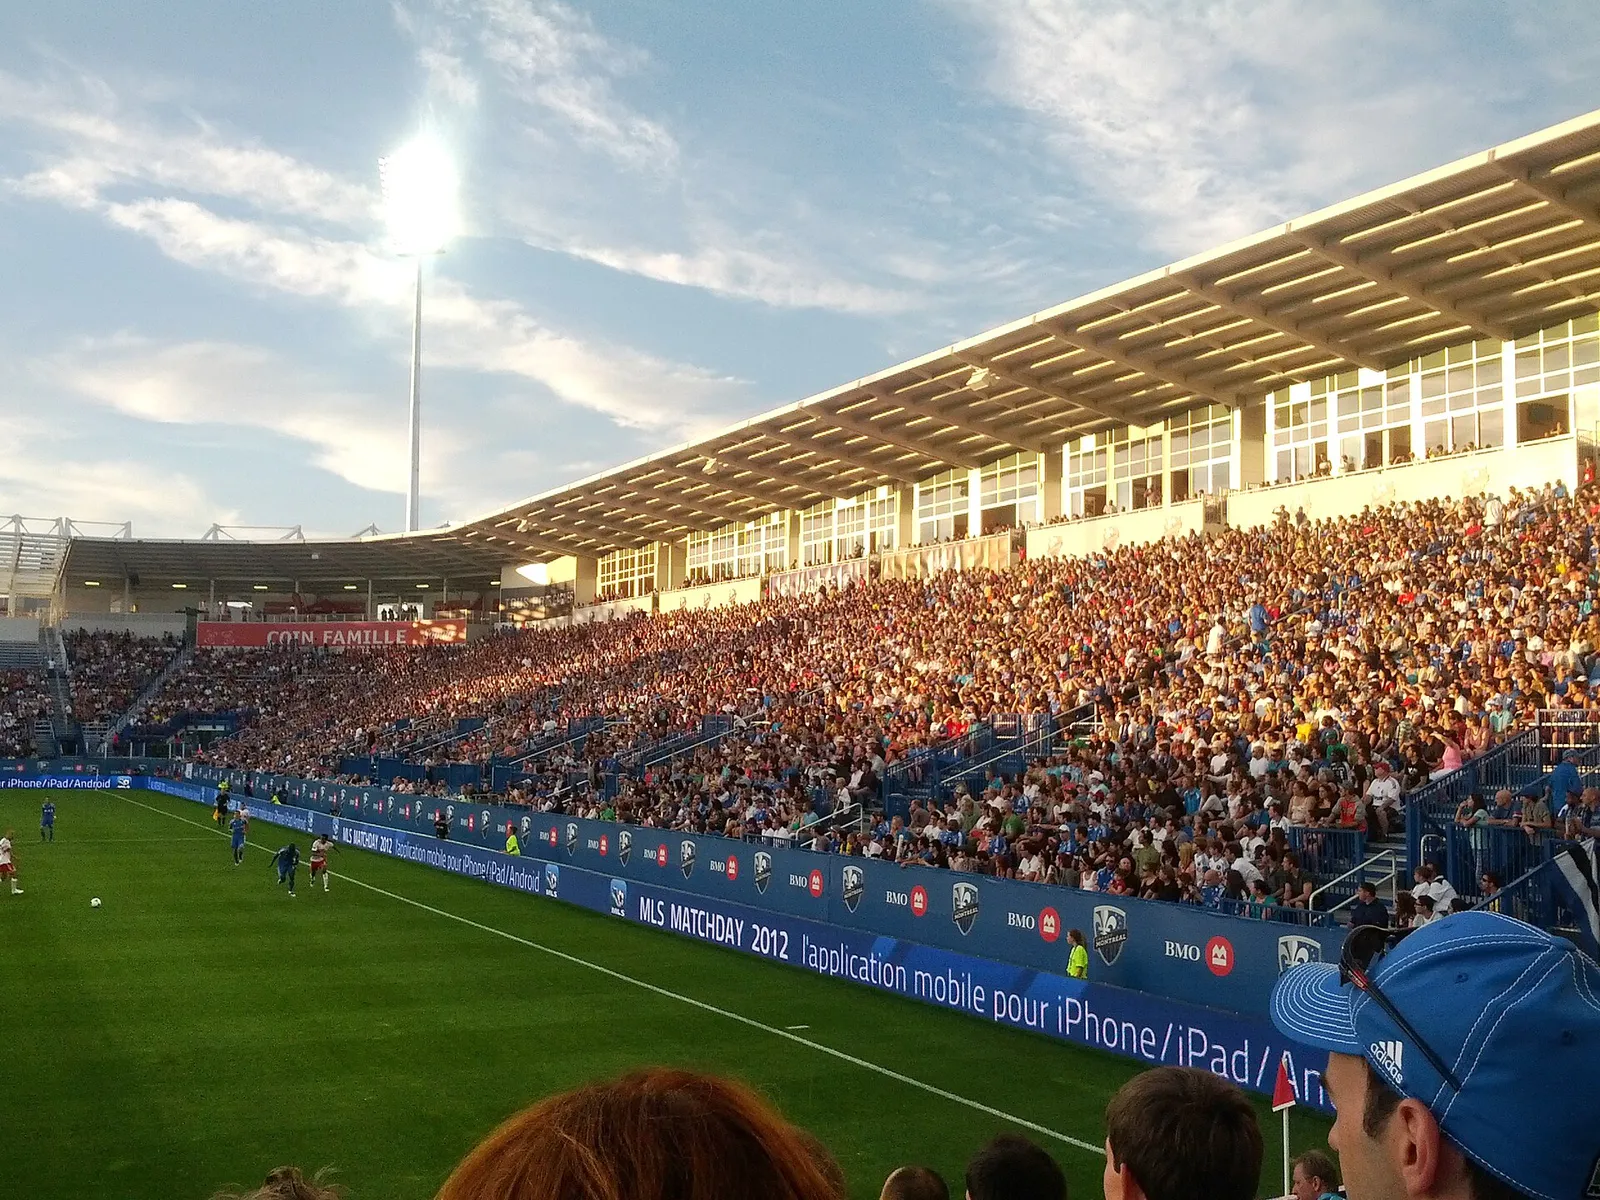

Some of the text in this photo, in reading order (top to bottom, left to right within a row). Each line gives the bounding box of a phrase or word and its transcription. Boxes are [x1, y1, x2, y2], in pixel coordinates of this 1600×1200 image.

[267, 629, 407, 646] COIN FAMILLE
[379, 835, 393, 854] 2012
[447, 854, 462, 872] pour
[643, 849, 657, 860] BMO
[709, 860, 726, 873] BMO
[789, 874, 808, 888] BMO
[886, 890, 908, 906] BMO
[610, 907, 626, 917] MLS
[1007, 912, 1035, 930] BMO
[1164, 940, 1201, 962] BMO
[639, 896, 665, 927] MLS
[670, 903, 744, 947] MATCHDAY
[751, 923, 789, 960] 2012
[802, 933, 907, 992] l'application
[914, 968, 985, 1013] mobile
[993, 989, 1049, 1029] pour
[1370, 1042, 1403, 1084] adidas
